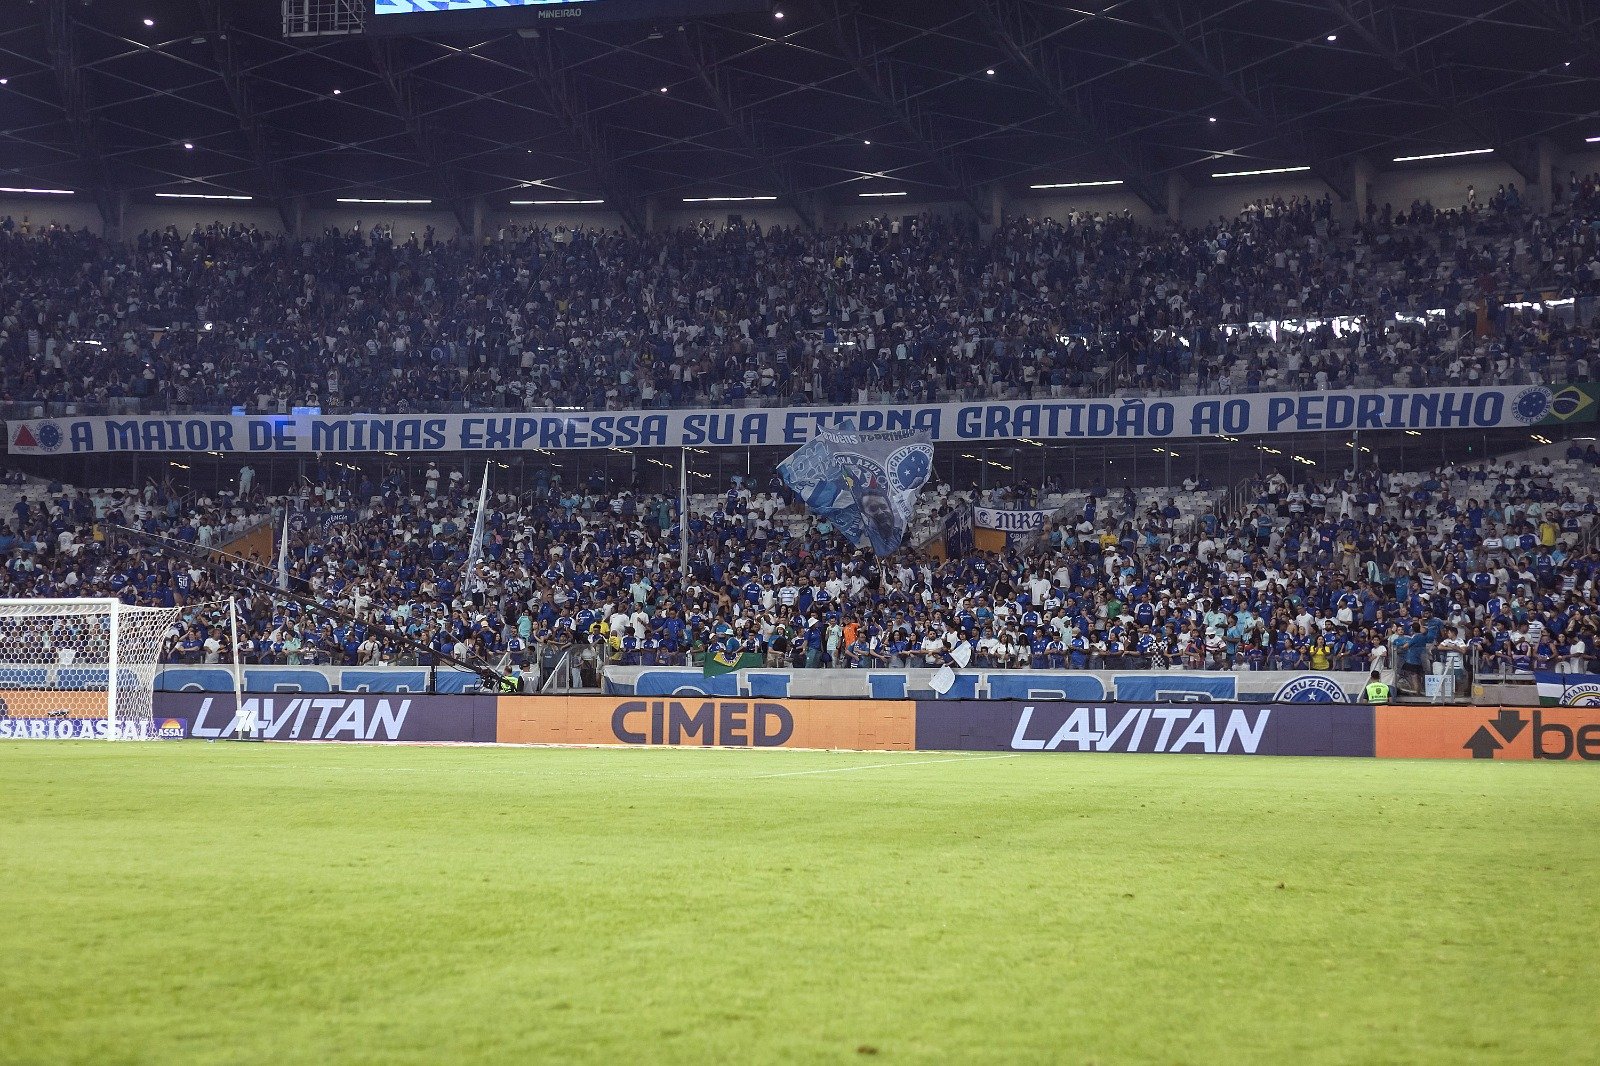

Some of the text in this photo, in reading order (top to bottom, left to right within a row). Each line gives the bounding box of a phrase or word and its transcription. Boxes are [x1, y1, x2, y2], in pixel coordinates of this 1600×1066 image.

[538, 8, 582, 18] MINEIRÃO
[70, 420, 94, 451] A
[105, 419, 235, 451] MAIOR
[248, 420, 297, 451] DE
[311, 418, 447, 451] MINAS
[459, 413, 669, 450] EXPRESSA
[682, 412, 769, 446] SUA
[956, 397, 1175, 439] GRATIDÃO
[1189, 399, 1251, 435] AO
[1267, 390, 1505, 431] PEDRINHO
[856, 458, 880, 475] AZUL
[1283, 679, 1341, 700] CRUZEIRO
[191, 697, 411, 740] LAVITAN
[611, 700, 794, 747] CIMED
[1010, 706, 1271, 754] LAVITAN
